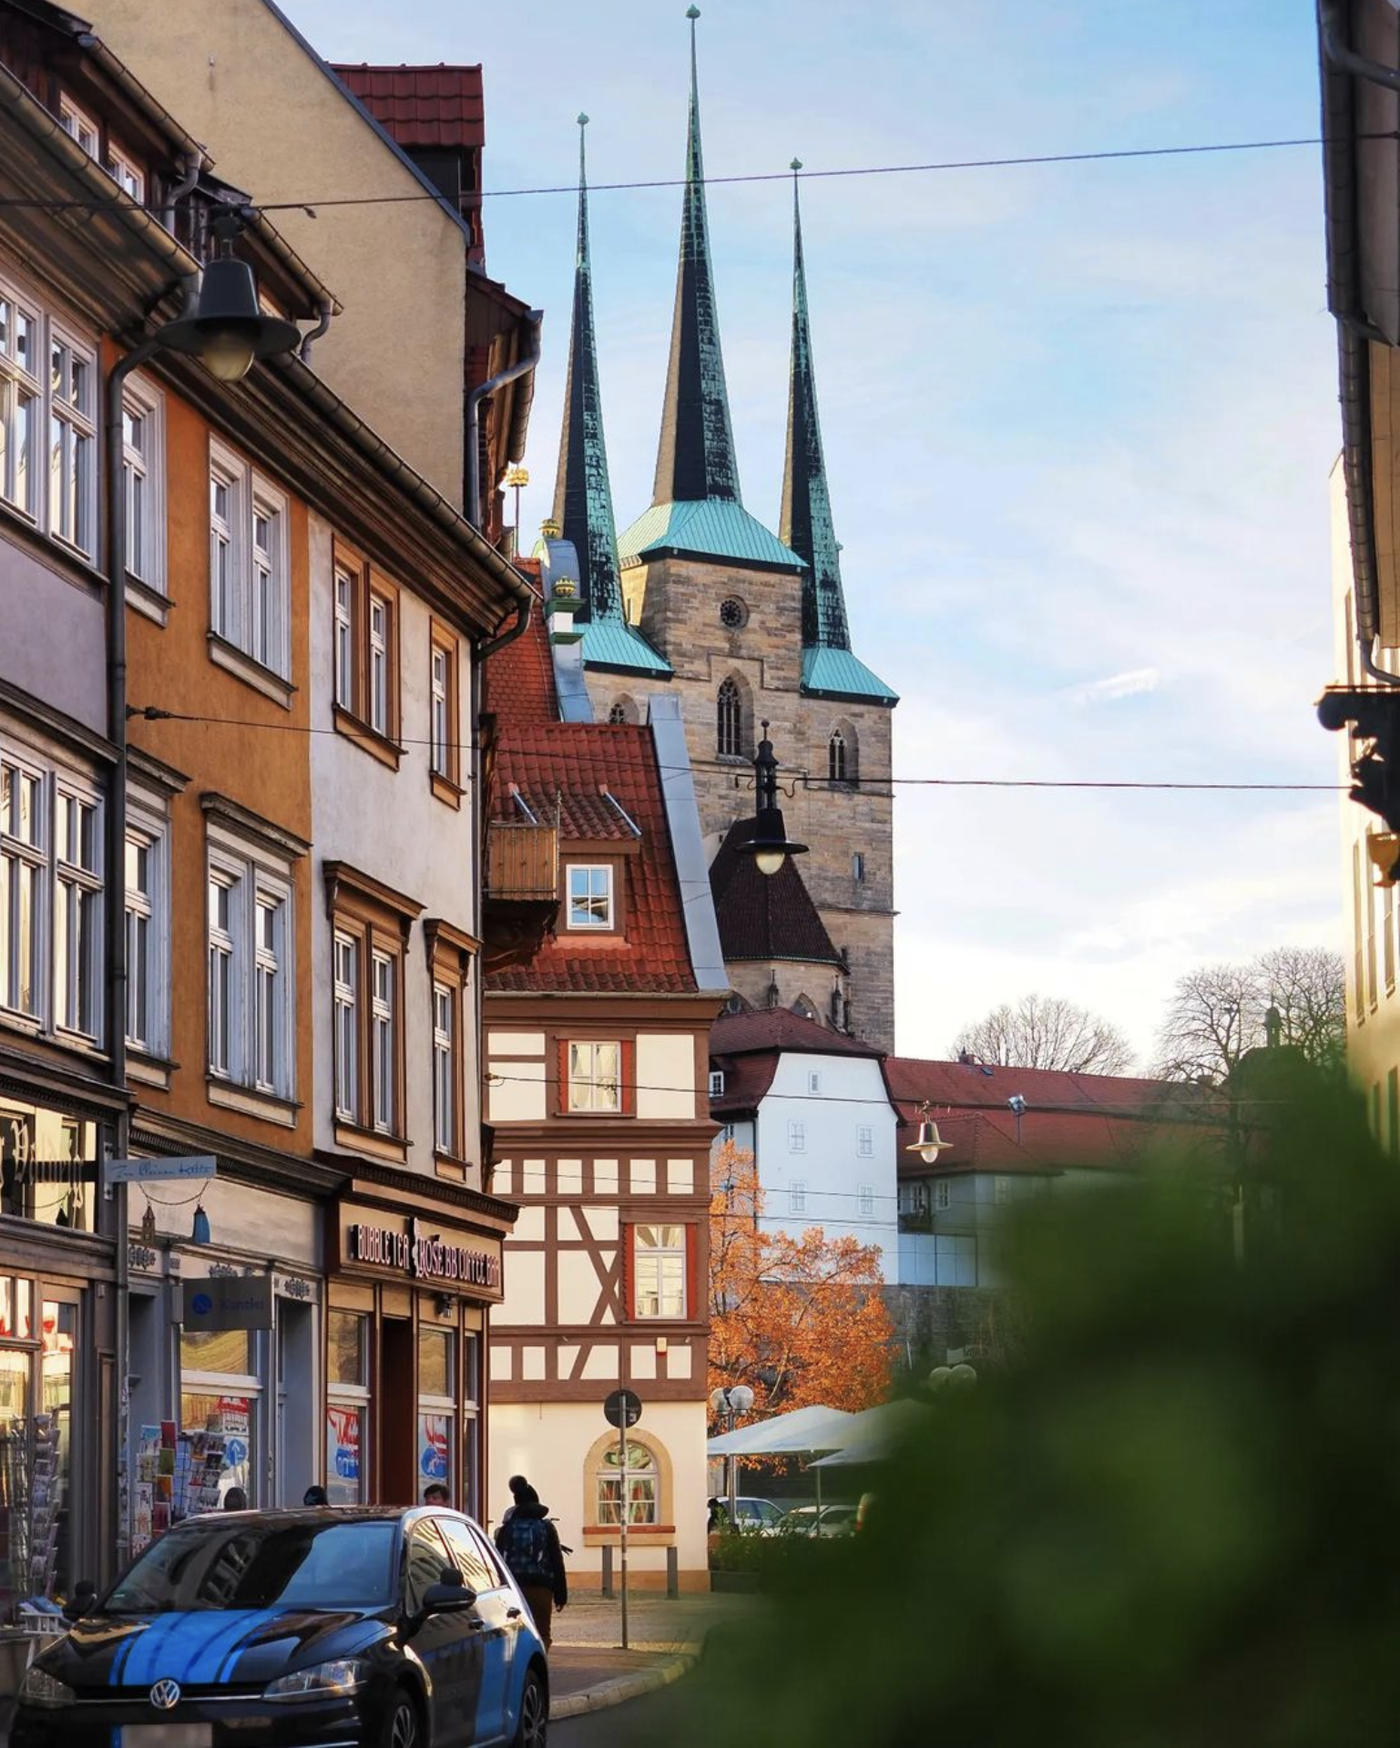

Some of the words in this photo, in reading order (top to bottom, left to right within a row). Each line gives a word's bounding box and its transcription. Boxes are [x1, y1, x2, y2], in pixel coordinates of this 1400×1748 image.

[358, 1224, 391, 1265] BUBBLE
[393, 1231, 410, 1269] TEA
[150, 1679, 181, 1710] VW
